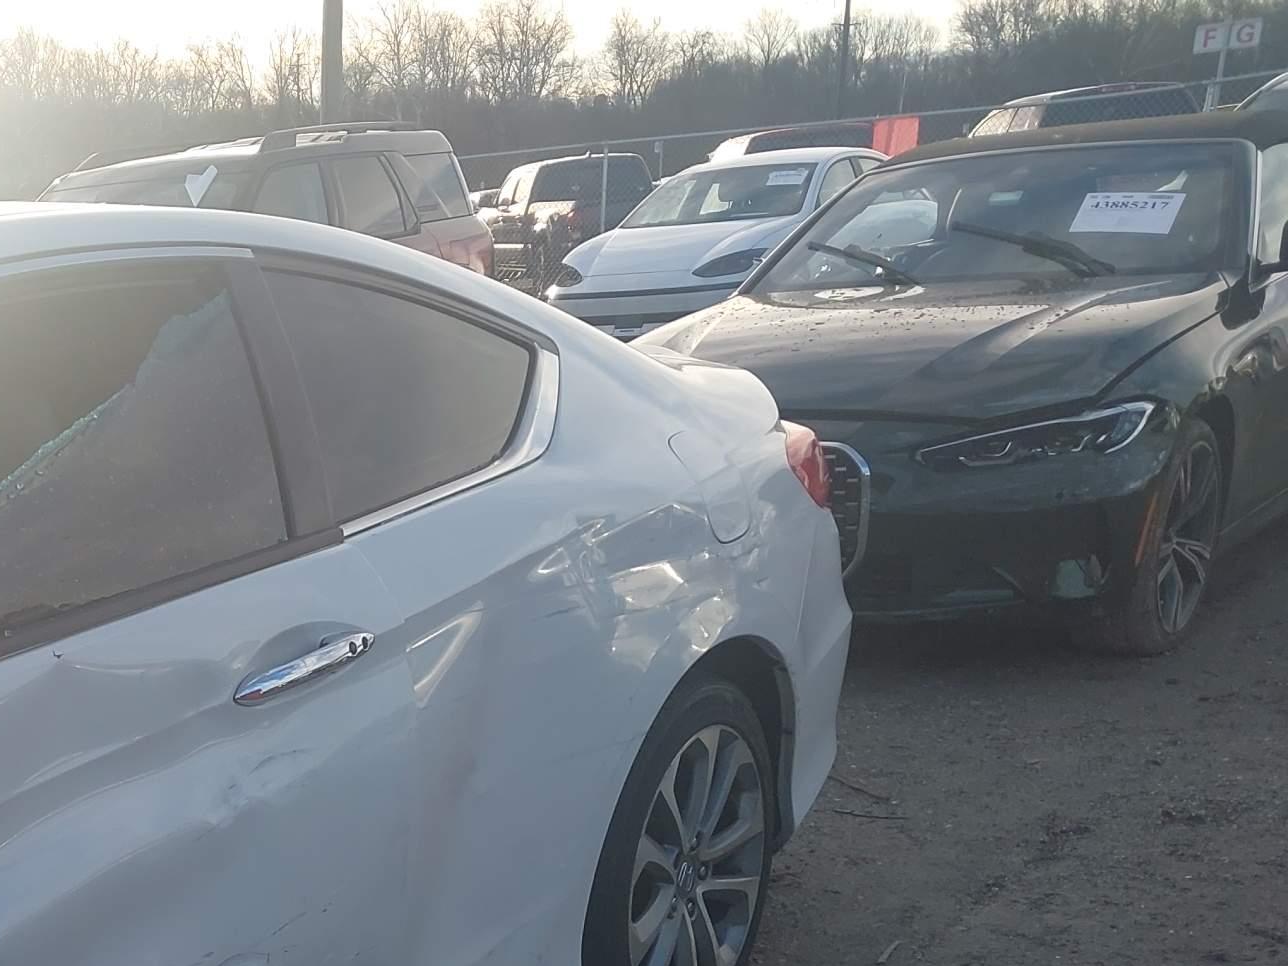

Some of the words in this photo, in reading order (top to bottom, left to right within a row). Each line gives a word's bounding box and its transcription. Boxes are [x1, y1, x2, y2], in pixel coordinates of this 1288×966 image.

[1202, 28, 1217, 49] F
[1236, 24, 1257, 43] G
[1089, 201, 1171, 209] 43885217
